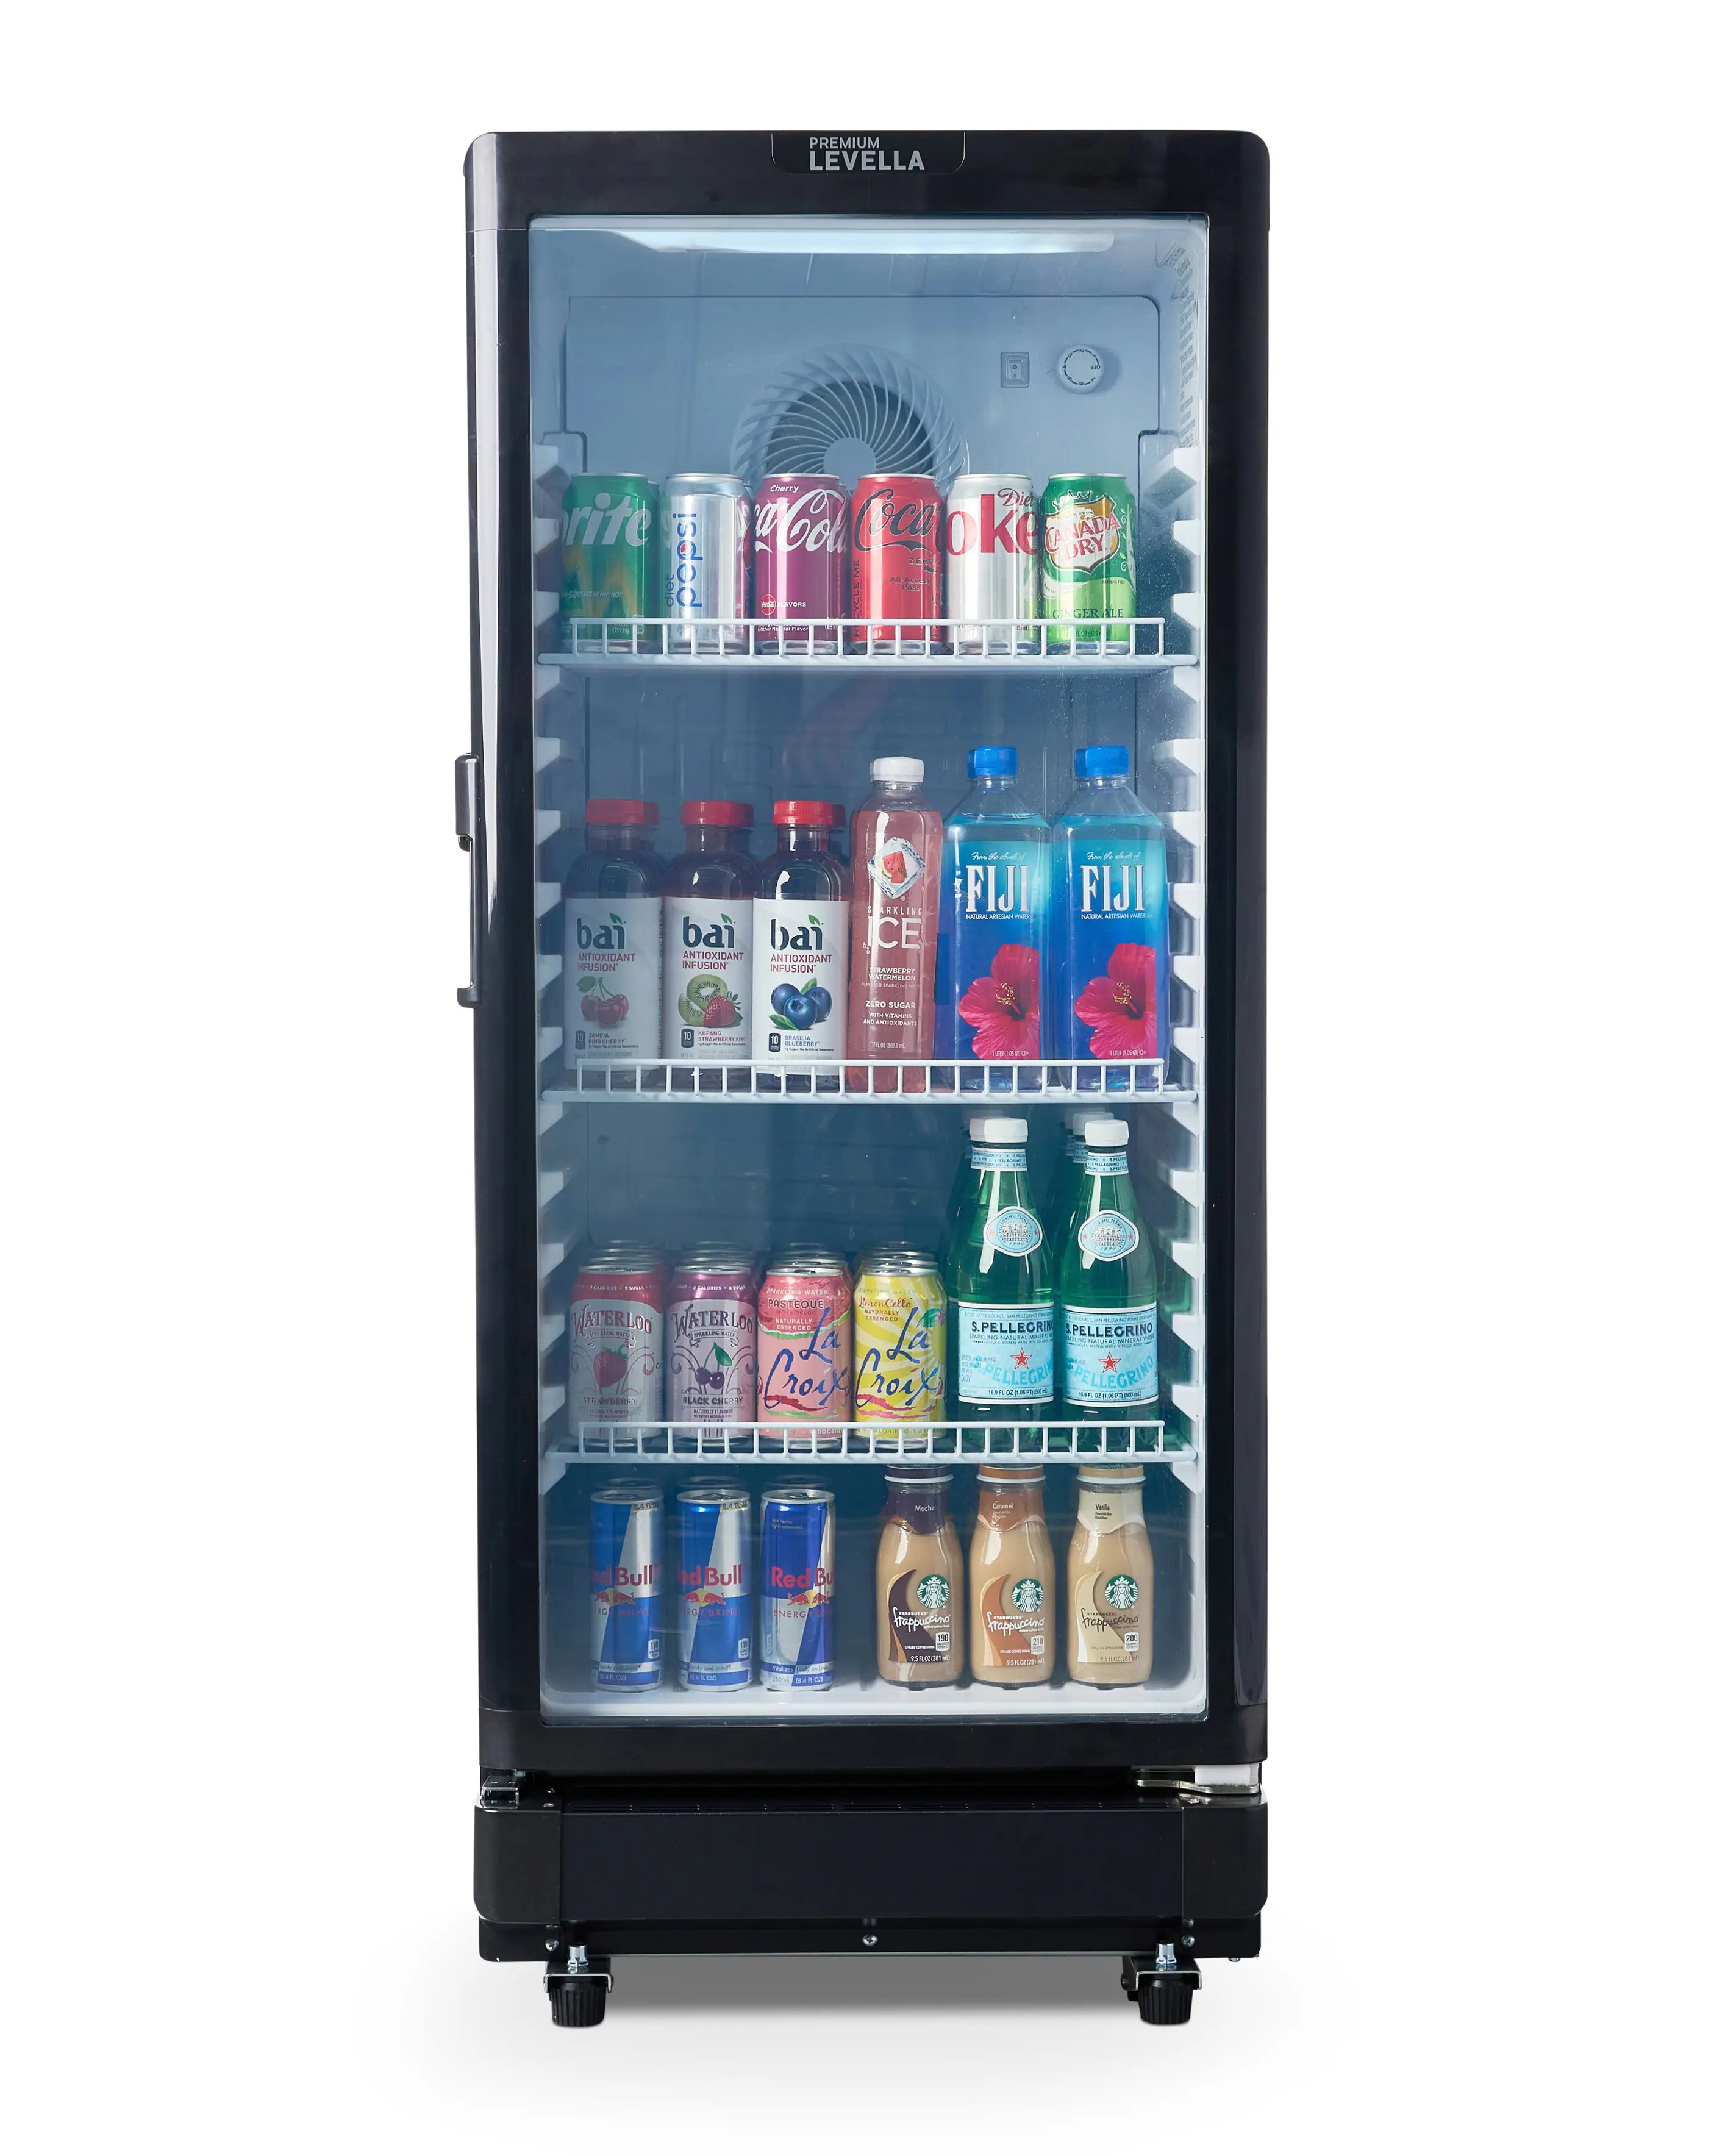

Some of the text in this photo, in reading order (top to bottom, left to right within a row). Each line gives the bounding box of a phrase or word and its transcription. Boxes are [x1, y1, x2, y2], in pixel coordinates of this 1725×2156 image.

[810, 137, 879, 149] PREMIUM
[810, 151, 924, 170] LEVELLA
[947, 494, 1038, 555] oke
[1045, 512, 1120, 552] CANADA
[1064, 535, 1104, 560] DRY
[673, 513, 703, 607] pepsi
[854, 560, 859, 578] ME
[665, 574, 674, 607] diet
[1052, 608, 1124, 619] GINGER ALE
[971, 851, 999, 860] From the
[1086, 851, 1113, 860] From the
[965, 865, 1030, 912] FIJI
[1080, 865, 1145, 912] FIJI
[868, 905, 922, 915] SARKLING
[577, 913, 624, 949] bai
[683, 913, 735, 948] bai
[770, 914, 823, 951] bai
[868, 916, 921, 949] ICE
[578, 953, 635, 962] ANTIOXIDANT
[682, 961, 729, 970] INFUSION
[683, 951, 744, 960] ANTIOXIDANT
[771, 954, 832, 963] ANTIOXIDANT
[578, 963, 618, 972] INFUSION
[770, 964, 816, 973] INFUSION
[684, 1032, 691, 1040] 10
[771, 1035, 779, 1044] 10
[768, 1299, 824, 1309] PASTEQUE
[572, 1304, 652, 1342] WATERLOO
[671, 1304, 752, 1343] WATERLOO
[1066, 1322, 1153, 1338] S.PELLEGRINO
[799, 1307, 841, 1364] La
[886, 1307, 930, 1364] La
[764, 1348, 848, 1409] Croix
[855, 1348, 939, 1408] Croix
[615, 1565, 652, 1586] Bull
[705, 1564, 741, 1587] Bull
[771, 1566, 810, 1588] Red
[773, 1609, 812, 1618] ENERGY
[893, 1606, 950, 1633] frappuccino
[987, 1611, 1045, 1637] frappuccino
[1080, 1607, 1139, 1633] frappuccino
[650, 1641, 659, 1649] 110
